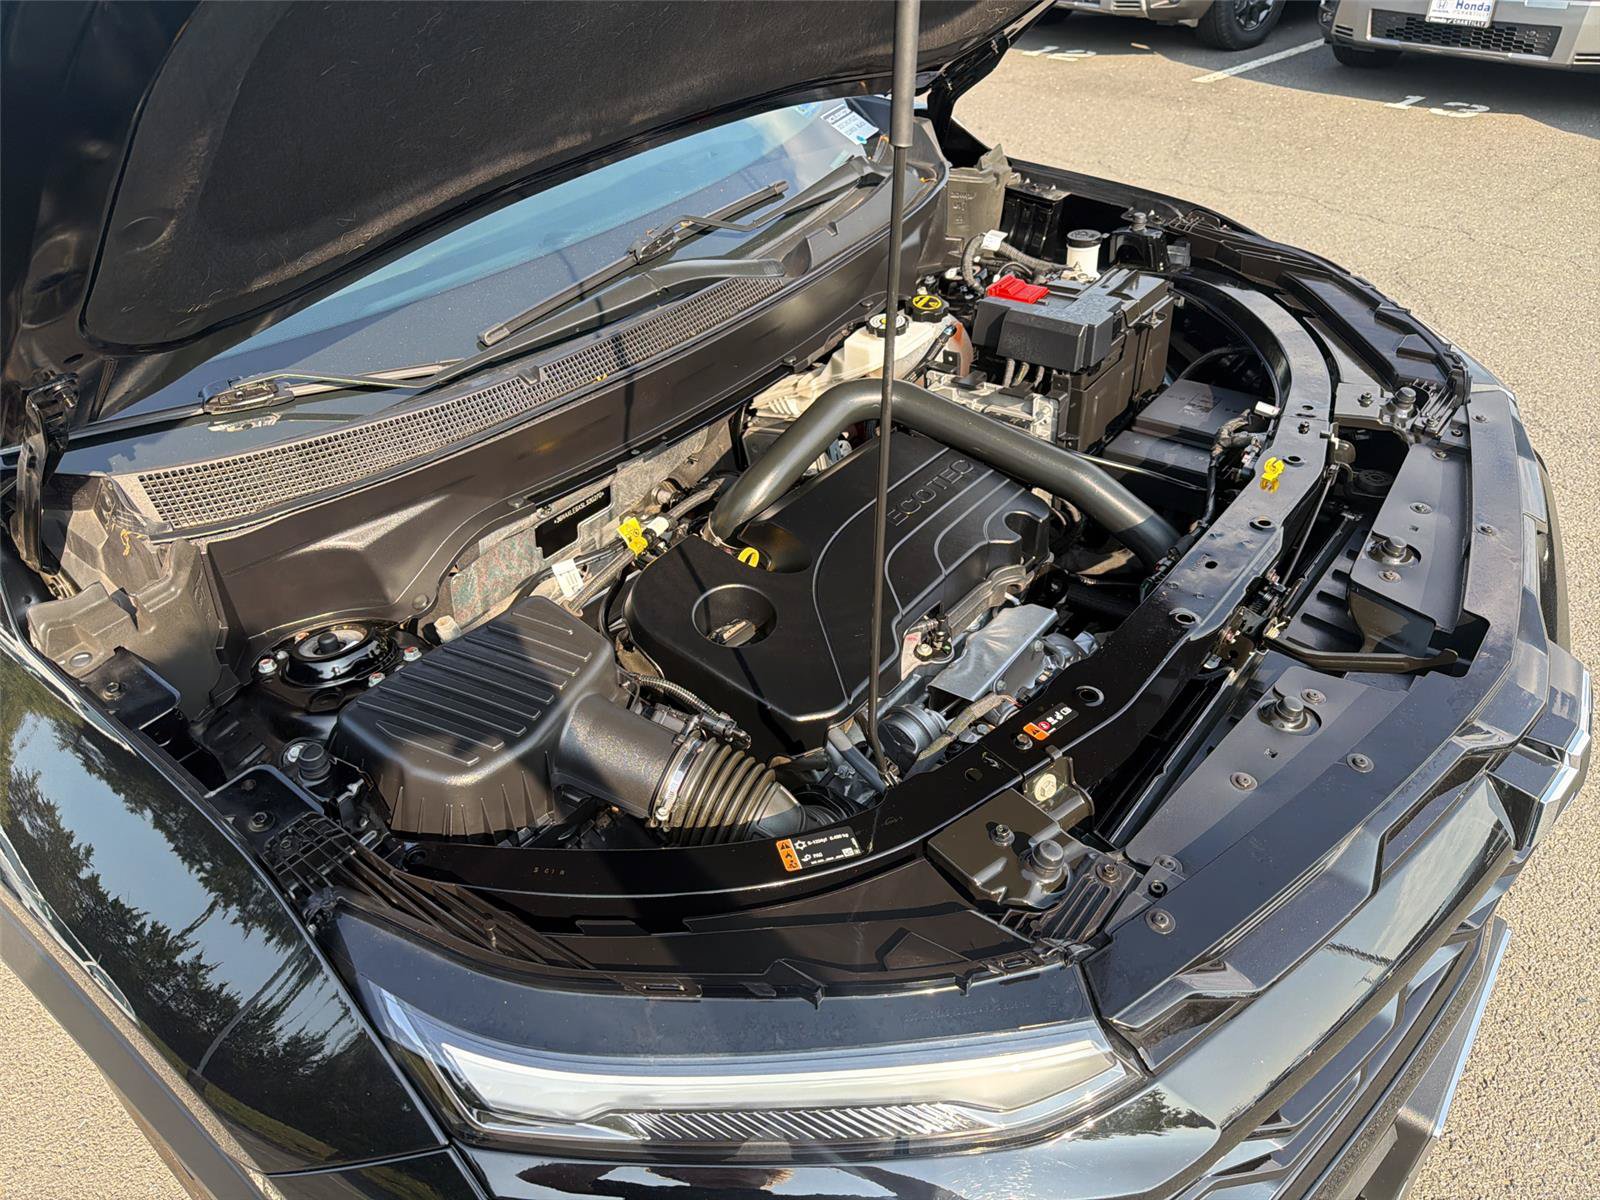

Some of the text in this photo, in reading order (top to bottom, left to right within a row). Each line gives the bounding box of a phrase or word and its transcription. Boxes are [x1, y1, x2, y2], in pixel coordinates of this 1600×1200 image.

[1456, 0, 1491, 11] Honda
[1022, 45, 1097, 61] 12
[1383, 95, 1490, 117] 13
[886, 458, 975, 527] ECOTEC
